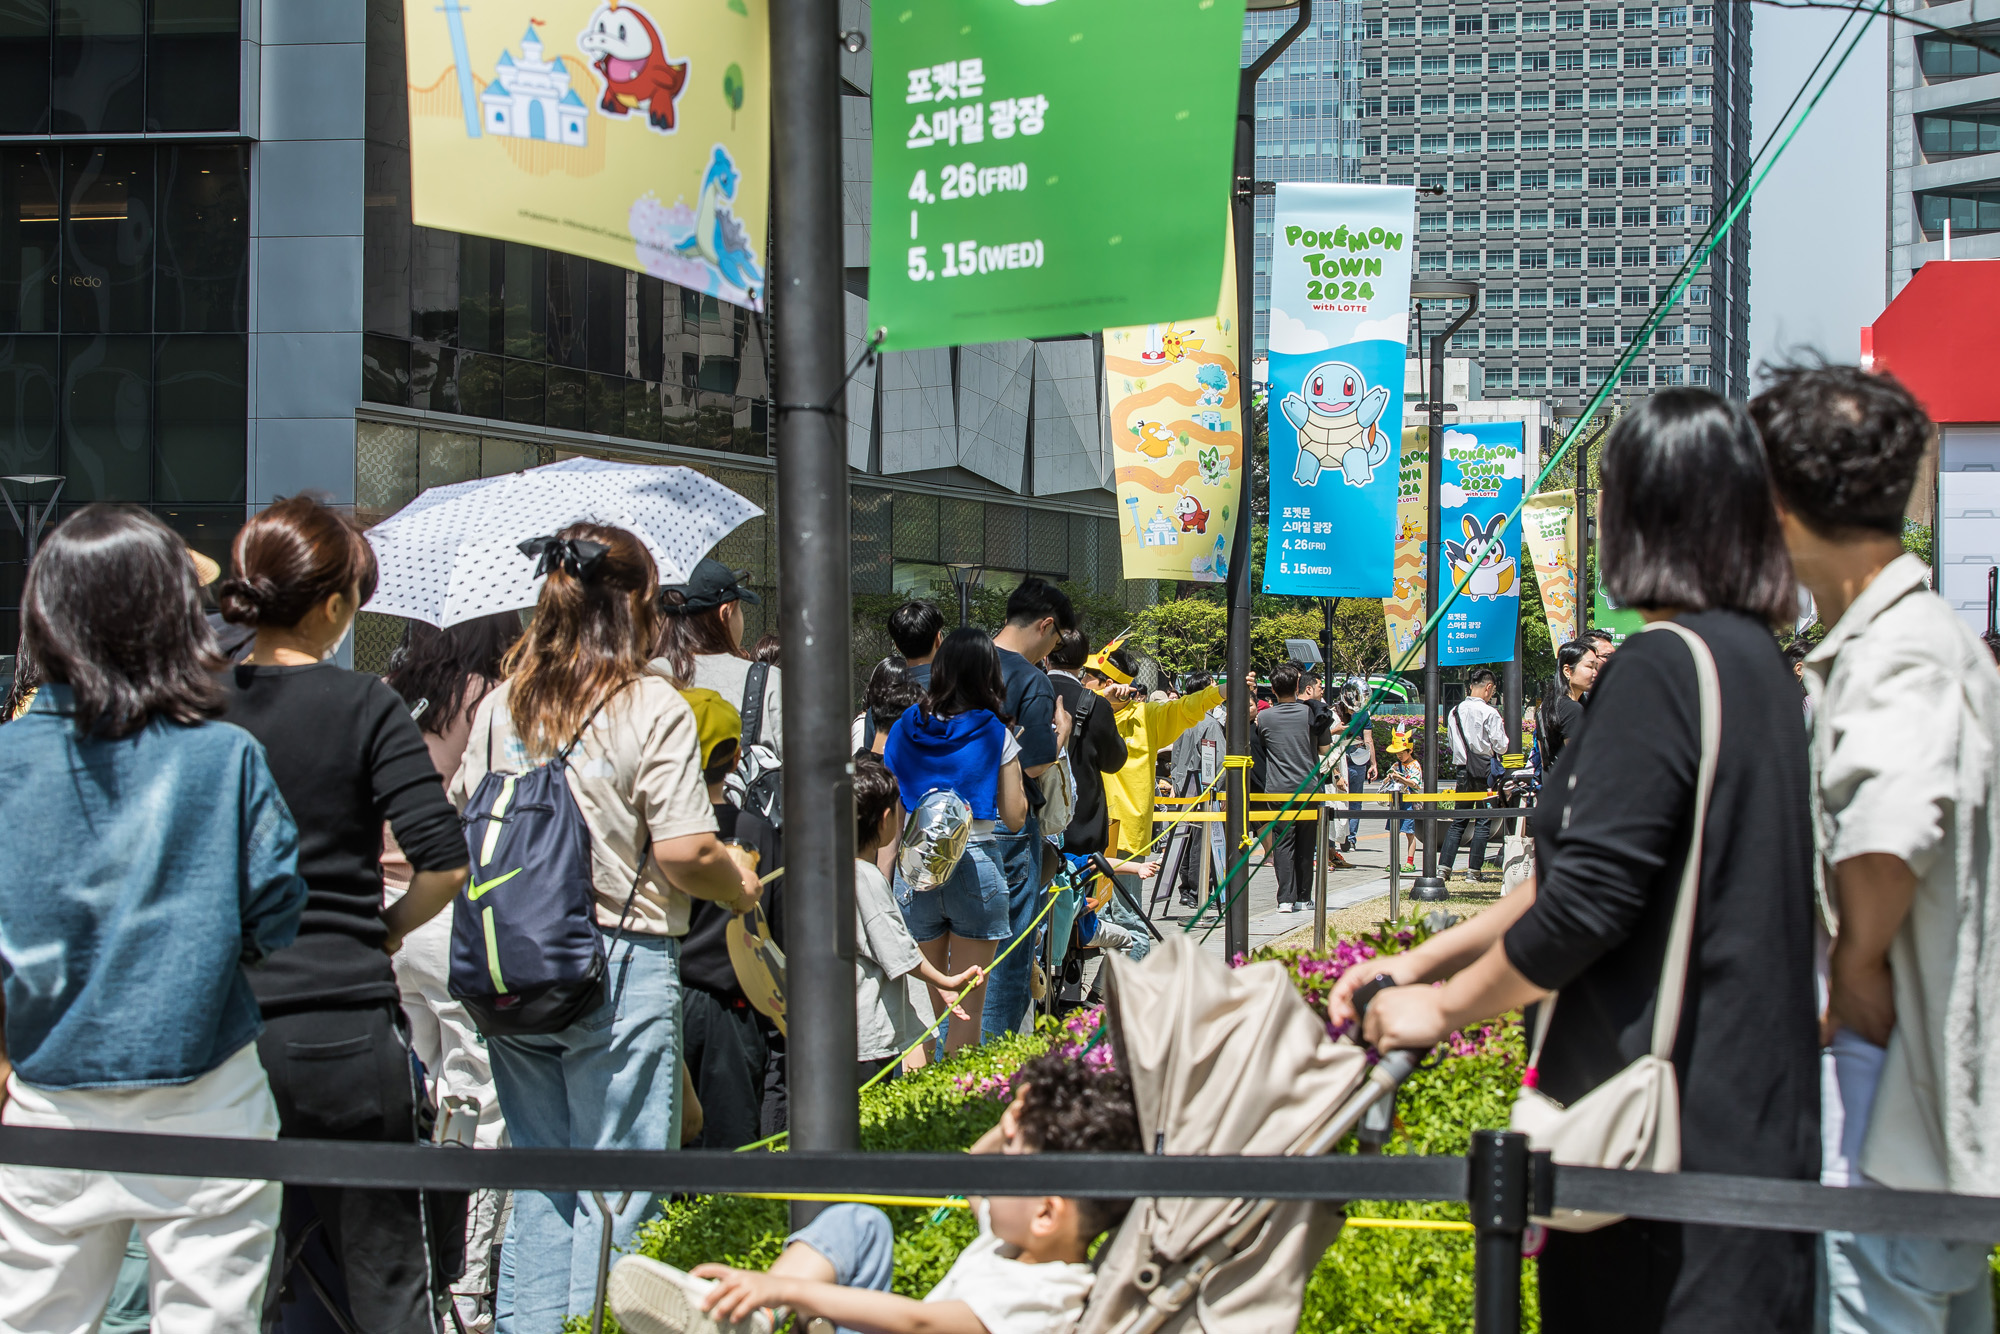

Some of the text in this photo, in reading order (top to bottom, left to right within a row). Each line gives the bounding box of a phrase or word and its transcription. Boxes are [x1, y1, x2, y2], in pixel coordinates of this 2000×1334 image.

[905, 57, 986, 105] 포켓몬
[906, 93, 1050, 149] 스마일 광장
[908, 169, 936, 204] 4.
[908, 246, 936, 282] 5.
[1306, 279, 1375, 301] 2024
[1312, 302, 1368, 313] with LOTTE
[1460, 478, 1503, 491] 2024
[1282, 506, 1312, 520] 포켓몬
[1281, 521, 1333, 535] 스마일 광장
[1281, 538, 1293, 551] 4.
[1280, 562, 1291, 575] 5.
